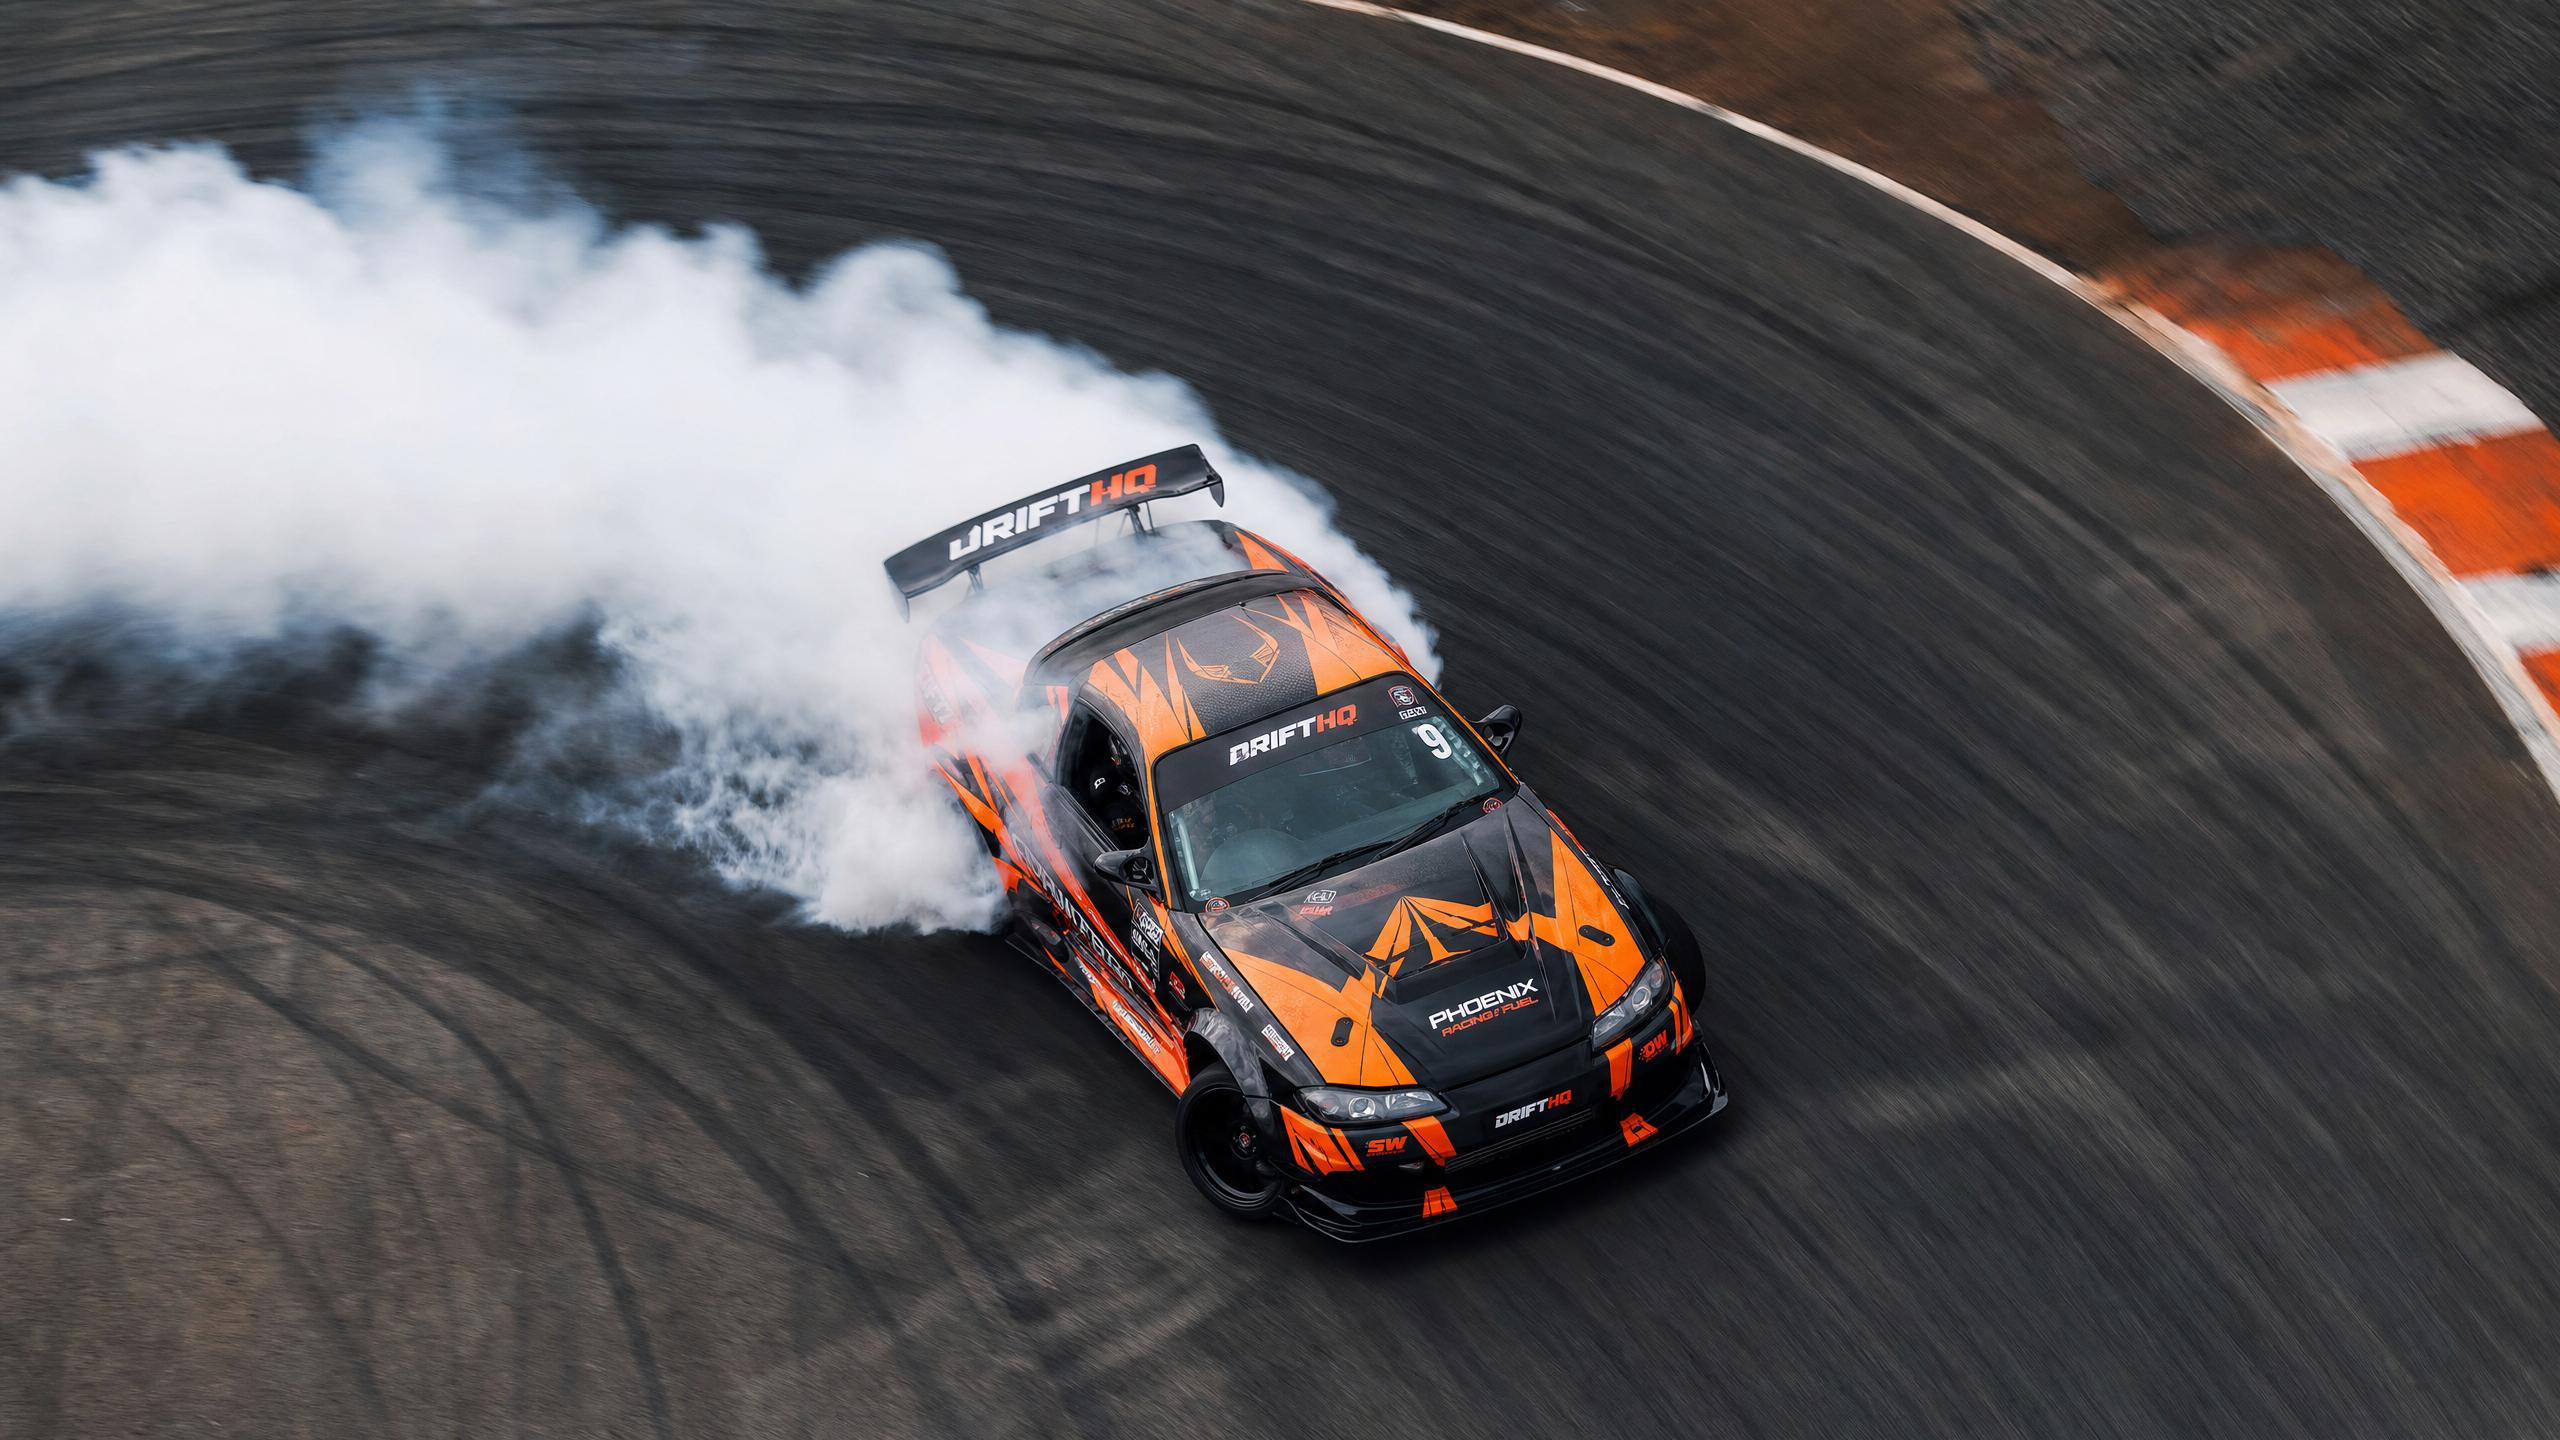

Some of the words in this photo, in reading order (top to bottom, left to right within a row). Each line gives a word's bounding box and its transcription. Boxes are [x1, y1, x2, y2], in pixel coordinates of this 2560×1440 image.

[1229, 703, 1358, 766] DRIFTHQ
[1417, 723, 1452, 759] 9
[1428, 978, 1539, 1030] PHOENIX
[1441, 1011, 1494, 1037] RACING
[1501, 996, 1539, 1014] FUEL
[1495, 1089, 1572, 1128] DRIFTHQ
[1367, 1135, 1408, 1153] SW
